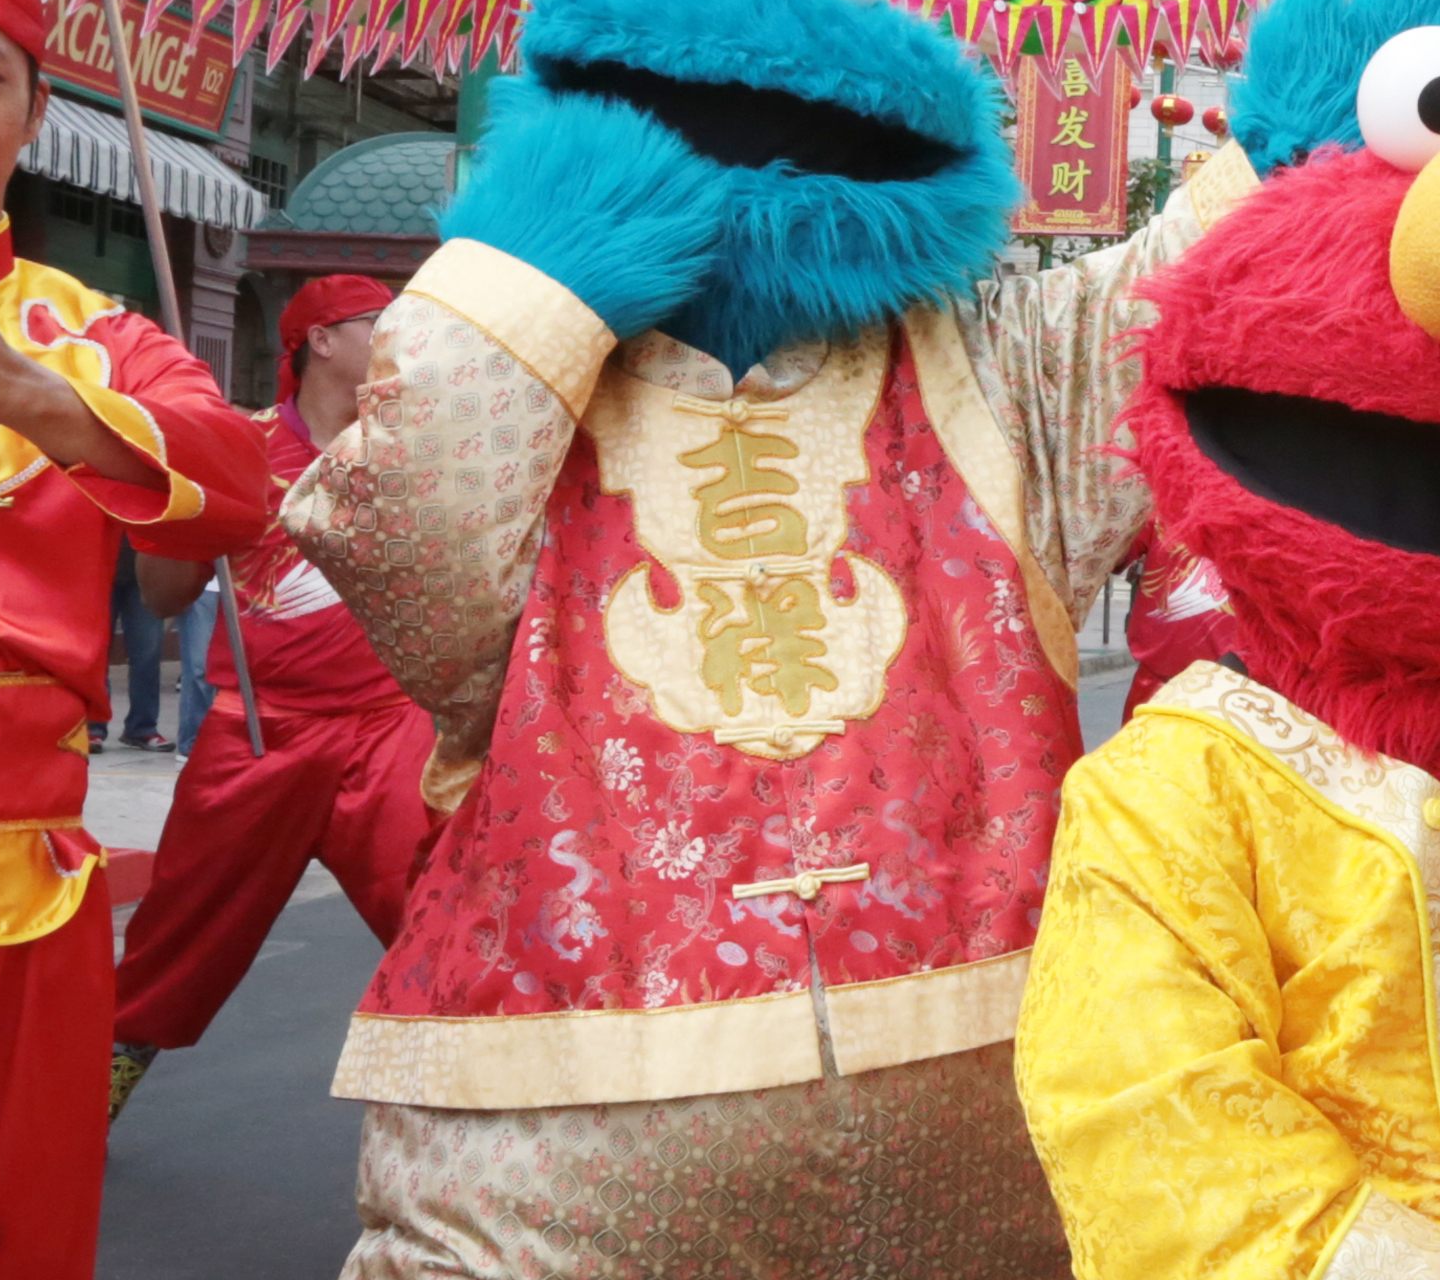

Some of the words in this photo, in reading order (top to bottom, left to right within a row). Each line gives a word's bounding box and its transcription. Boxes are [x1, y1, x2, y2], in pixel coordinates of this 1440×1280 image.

[201, 65, 224, 95] 102
[1048, 58, 1096, 202] 喜发财
